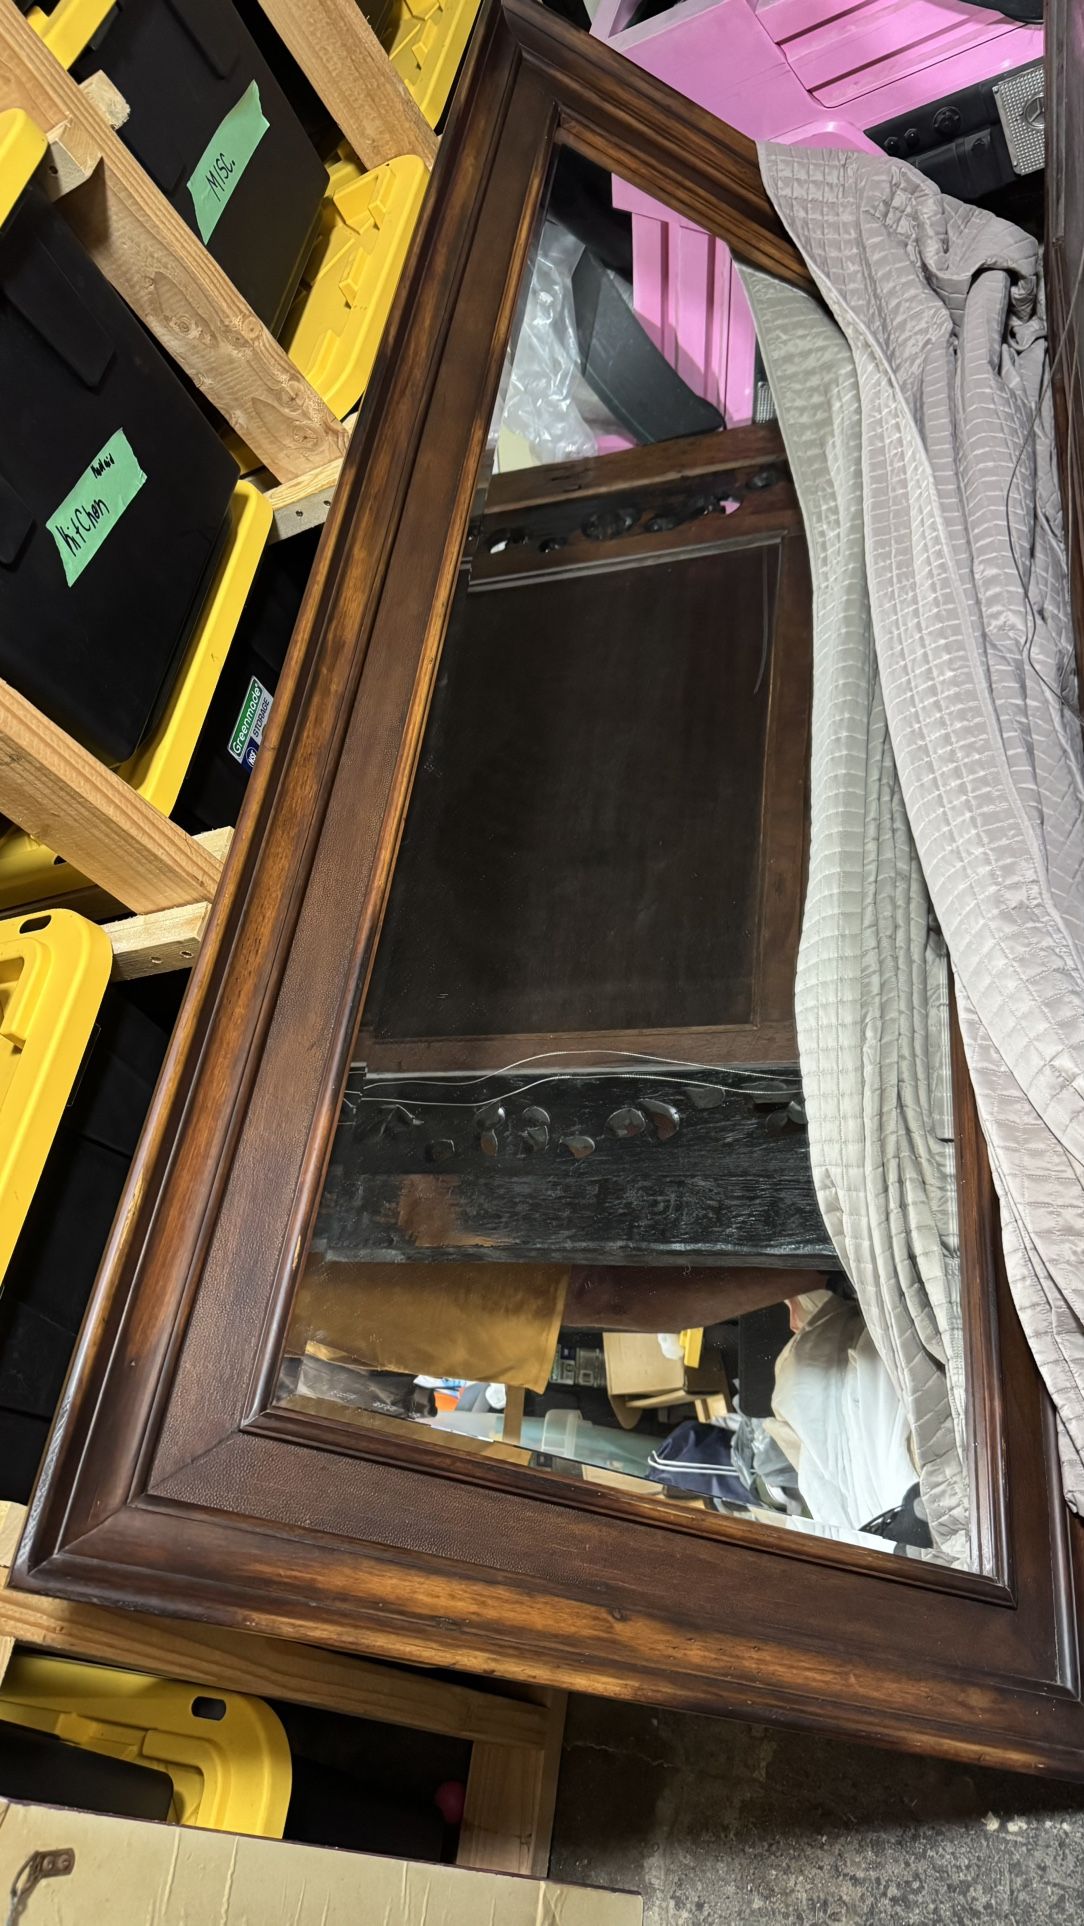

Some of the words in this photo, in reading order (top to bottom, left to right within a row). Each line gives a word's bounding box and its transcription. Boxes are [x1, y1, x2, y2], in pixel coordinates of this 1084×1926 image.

[205, 152, 236, 202] MISC.
[232, 686, 261, 754] Greenmade
[252, 697, 270, 738] STORAGE
